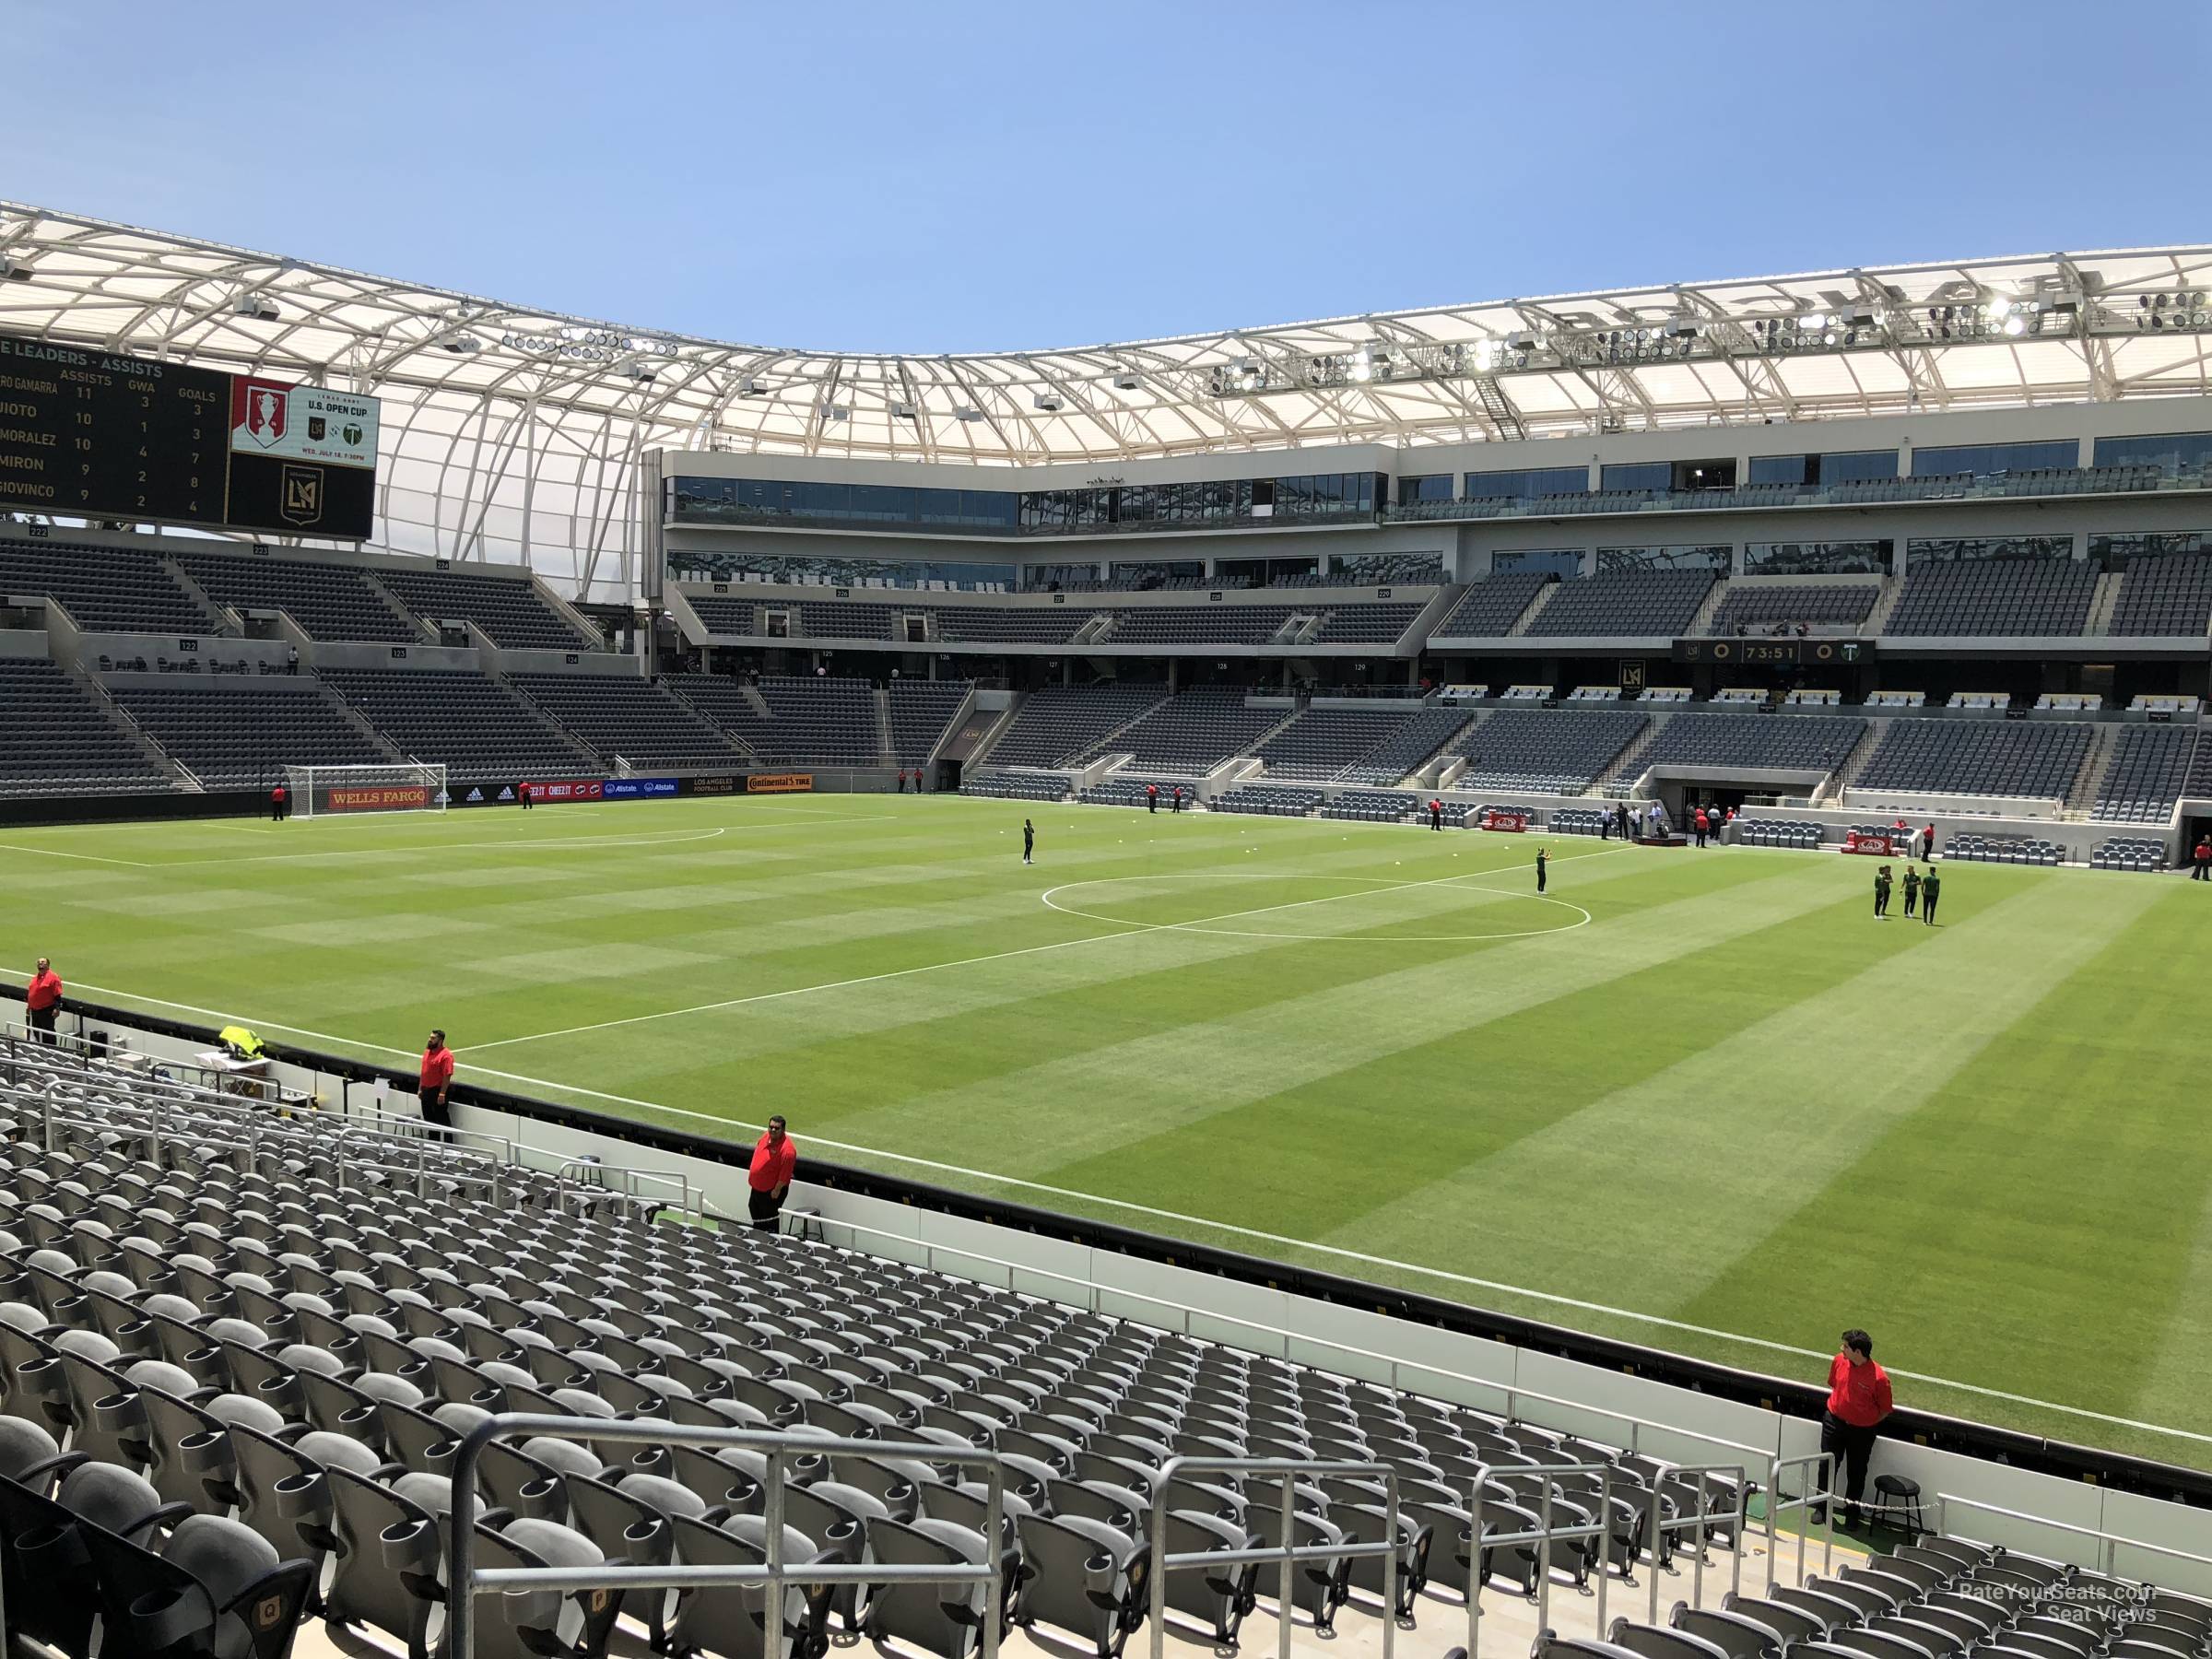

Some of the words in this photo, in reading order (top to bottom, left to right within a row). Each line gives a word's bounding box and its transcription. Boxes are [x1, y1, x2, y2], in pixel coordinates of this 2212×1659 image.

[15, 344, 88, 366] LEADERS
[101, 358, 163, 378] ASSISTS
[60, 370, 112, 386] ASSISTS
[128, 380, 155, 394] GWA
[179, 388, 216, 402] GOALS
[15, 377, 58, 394] GAMARRA
[77, 387, 91, 399] 11
[142, 397, 149, 407] 3
[194, 405, 201, 415] 3
[309, 400, 324, 411] U.S.
[326, 403, 349, 415] OPEN
[350, 407, 368, 418] CUP
[76, 413, 91, 425] 10
[141, 422, 147, 432] 1
[193, 429, 200, 440] 3
[0, 429, 56, 445] MORALEZ
[76, 438, 91, 451] 10
[193, 453, 200, 464] 7
[82, 465, 89, 476] 9
[138, 471, 147, 482] 2
[81, 489, 88, 500] 9
[137, 496, 146, 507] 2
[1747, 647, 1794, 658] 73:51
[749, 777, 788, 790] Continental
[334, 794, 380, 803] WELLS
[265, 1604, 275, 1618] Q
